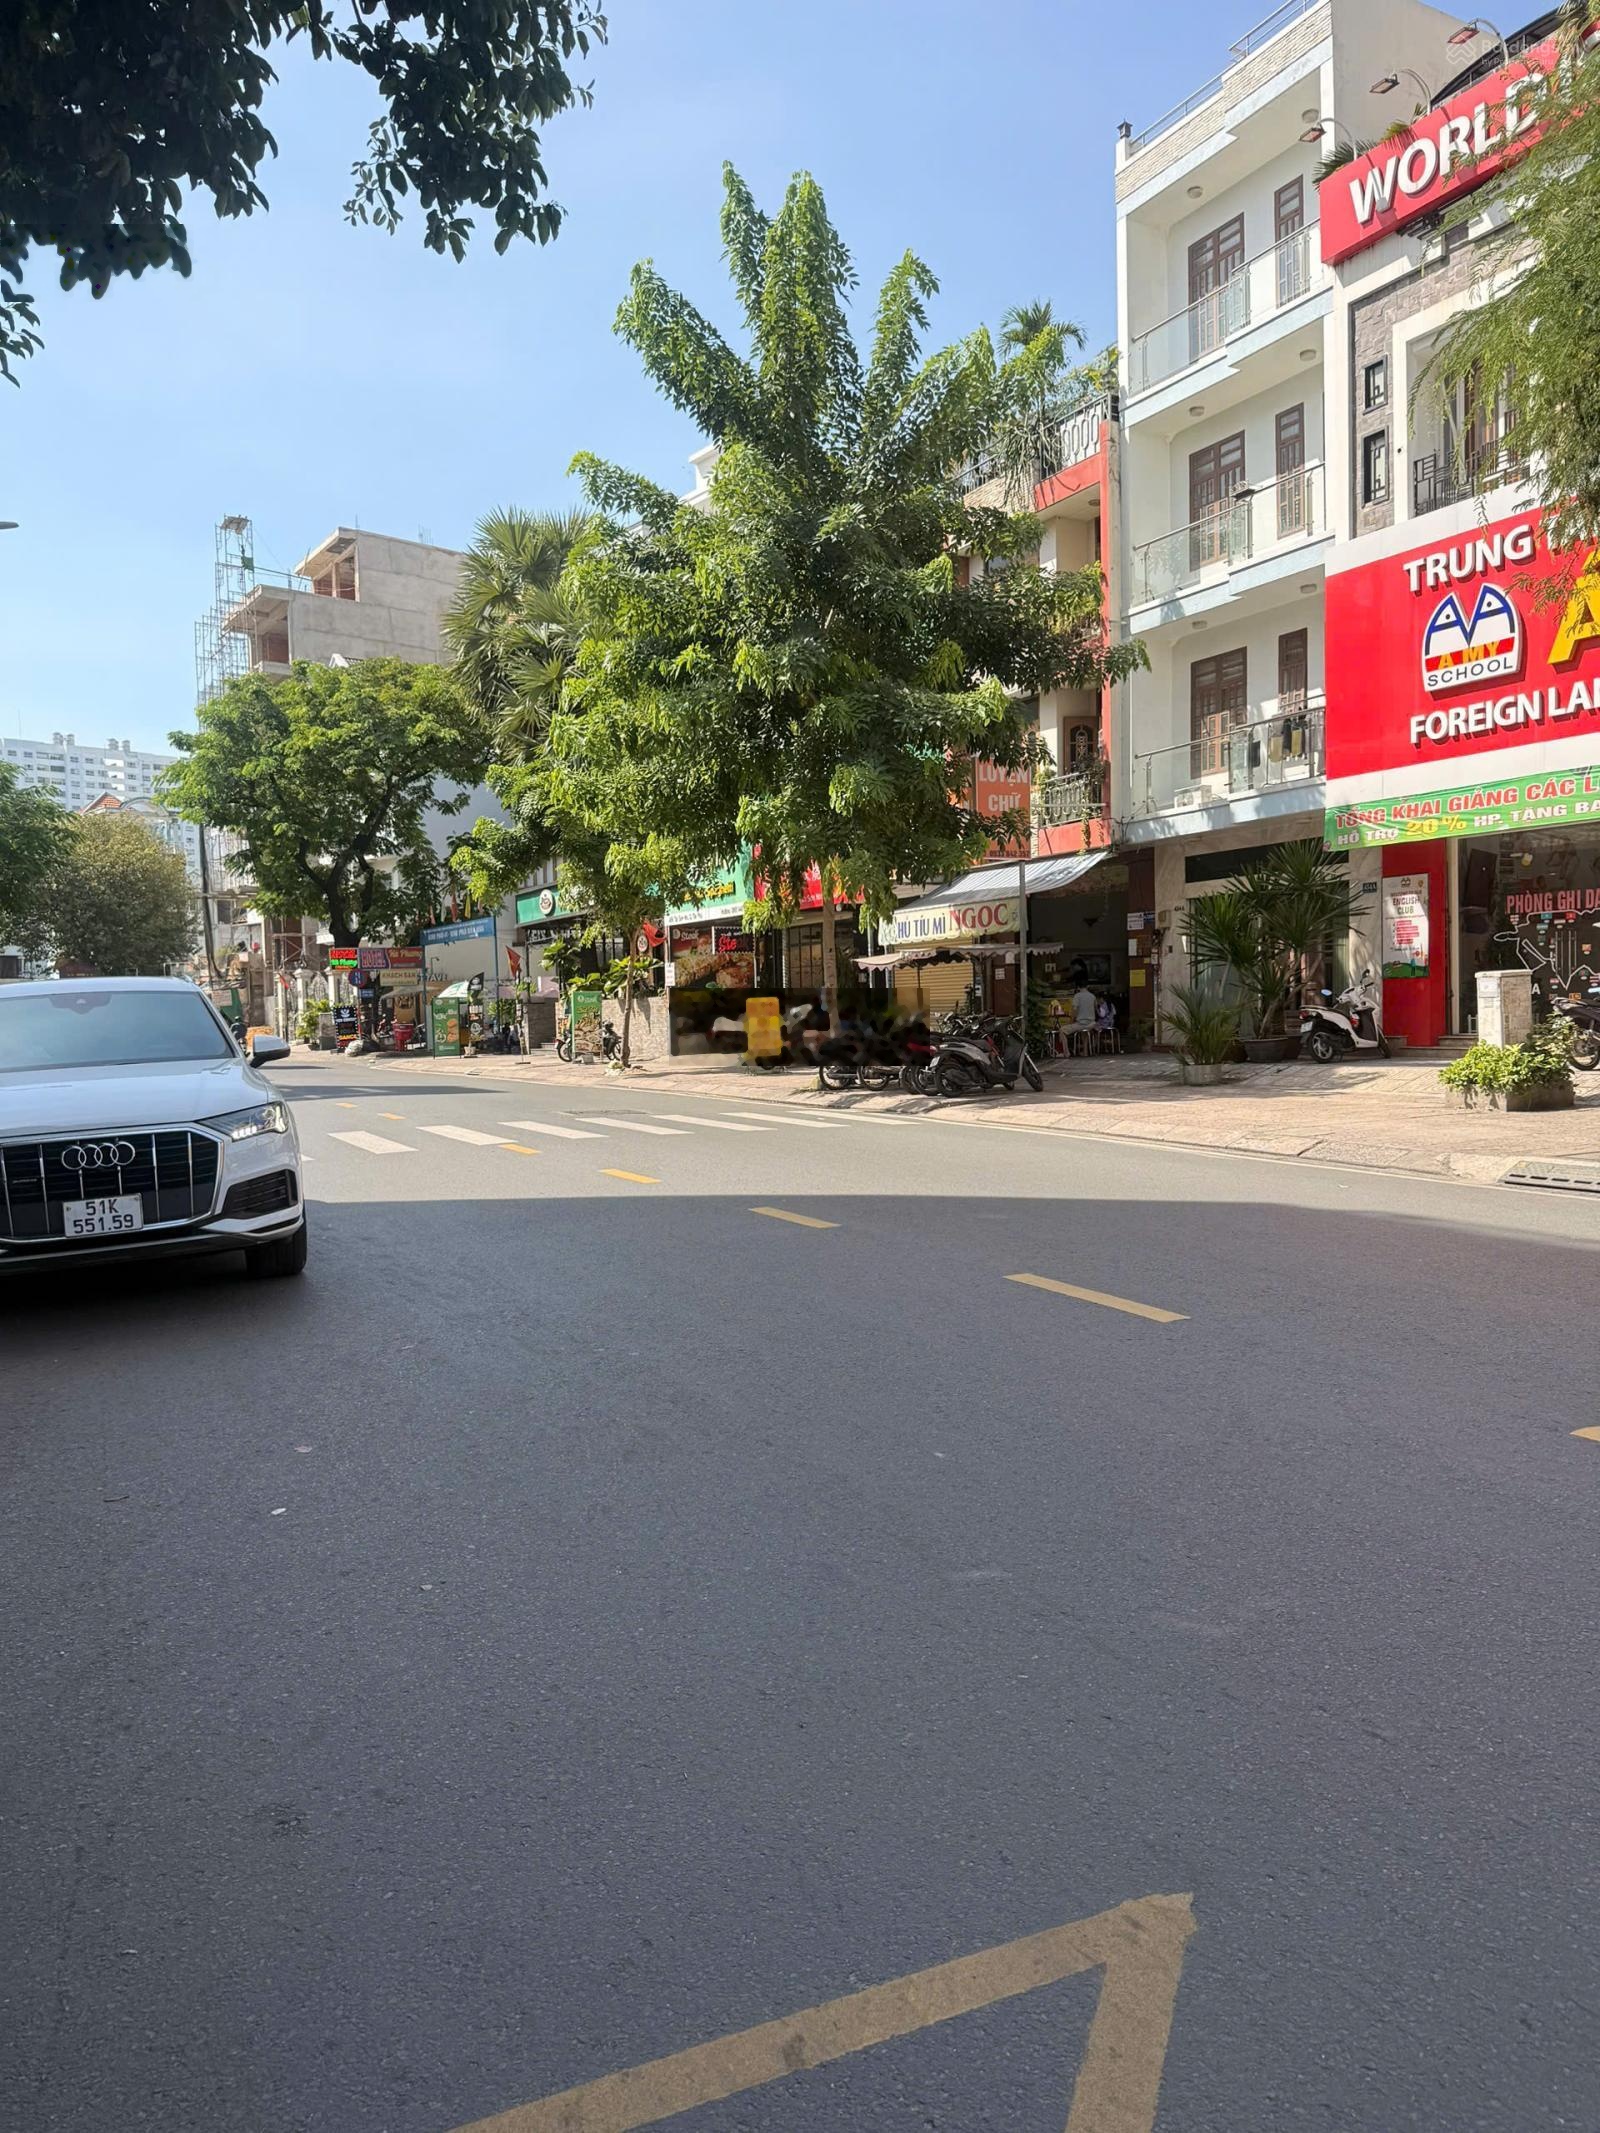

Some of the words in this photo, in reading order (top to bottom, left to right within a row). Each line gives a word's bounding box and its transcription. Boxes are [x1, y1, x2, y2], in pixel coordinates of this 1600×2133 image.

[1349, 72, 1548, 224] WORLD
[1403, 524, 1532, 592] TRUNG
[1428, 657, 1513, 687] SCHOOL
[1411, 688, 1541, 745] FOREIGN
[1391, 800, 1441, 821] KHAI
[1448, 785, 1518, 813] GIẢNG
[1526, 776, 1575, 800] CÁC
[1392, 895, 1420, 906] ENGLISH
[1397, 906, 1414, 915] CLUB
[1506, 890, 1553, 914] PHÒNG
[1557, 889, 1581, 911] GHI
[914, 914, 930, 938] TÍU
[933, 912, 946, 935] MÌ
[949, 903, 1008, 933] NGỌC
[86, 1198, 119, 1216] 51K
[73, 1214, 134, 1234] 551.59
